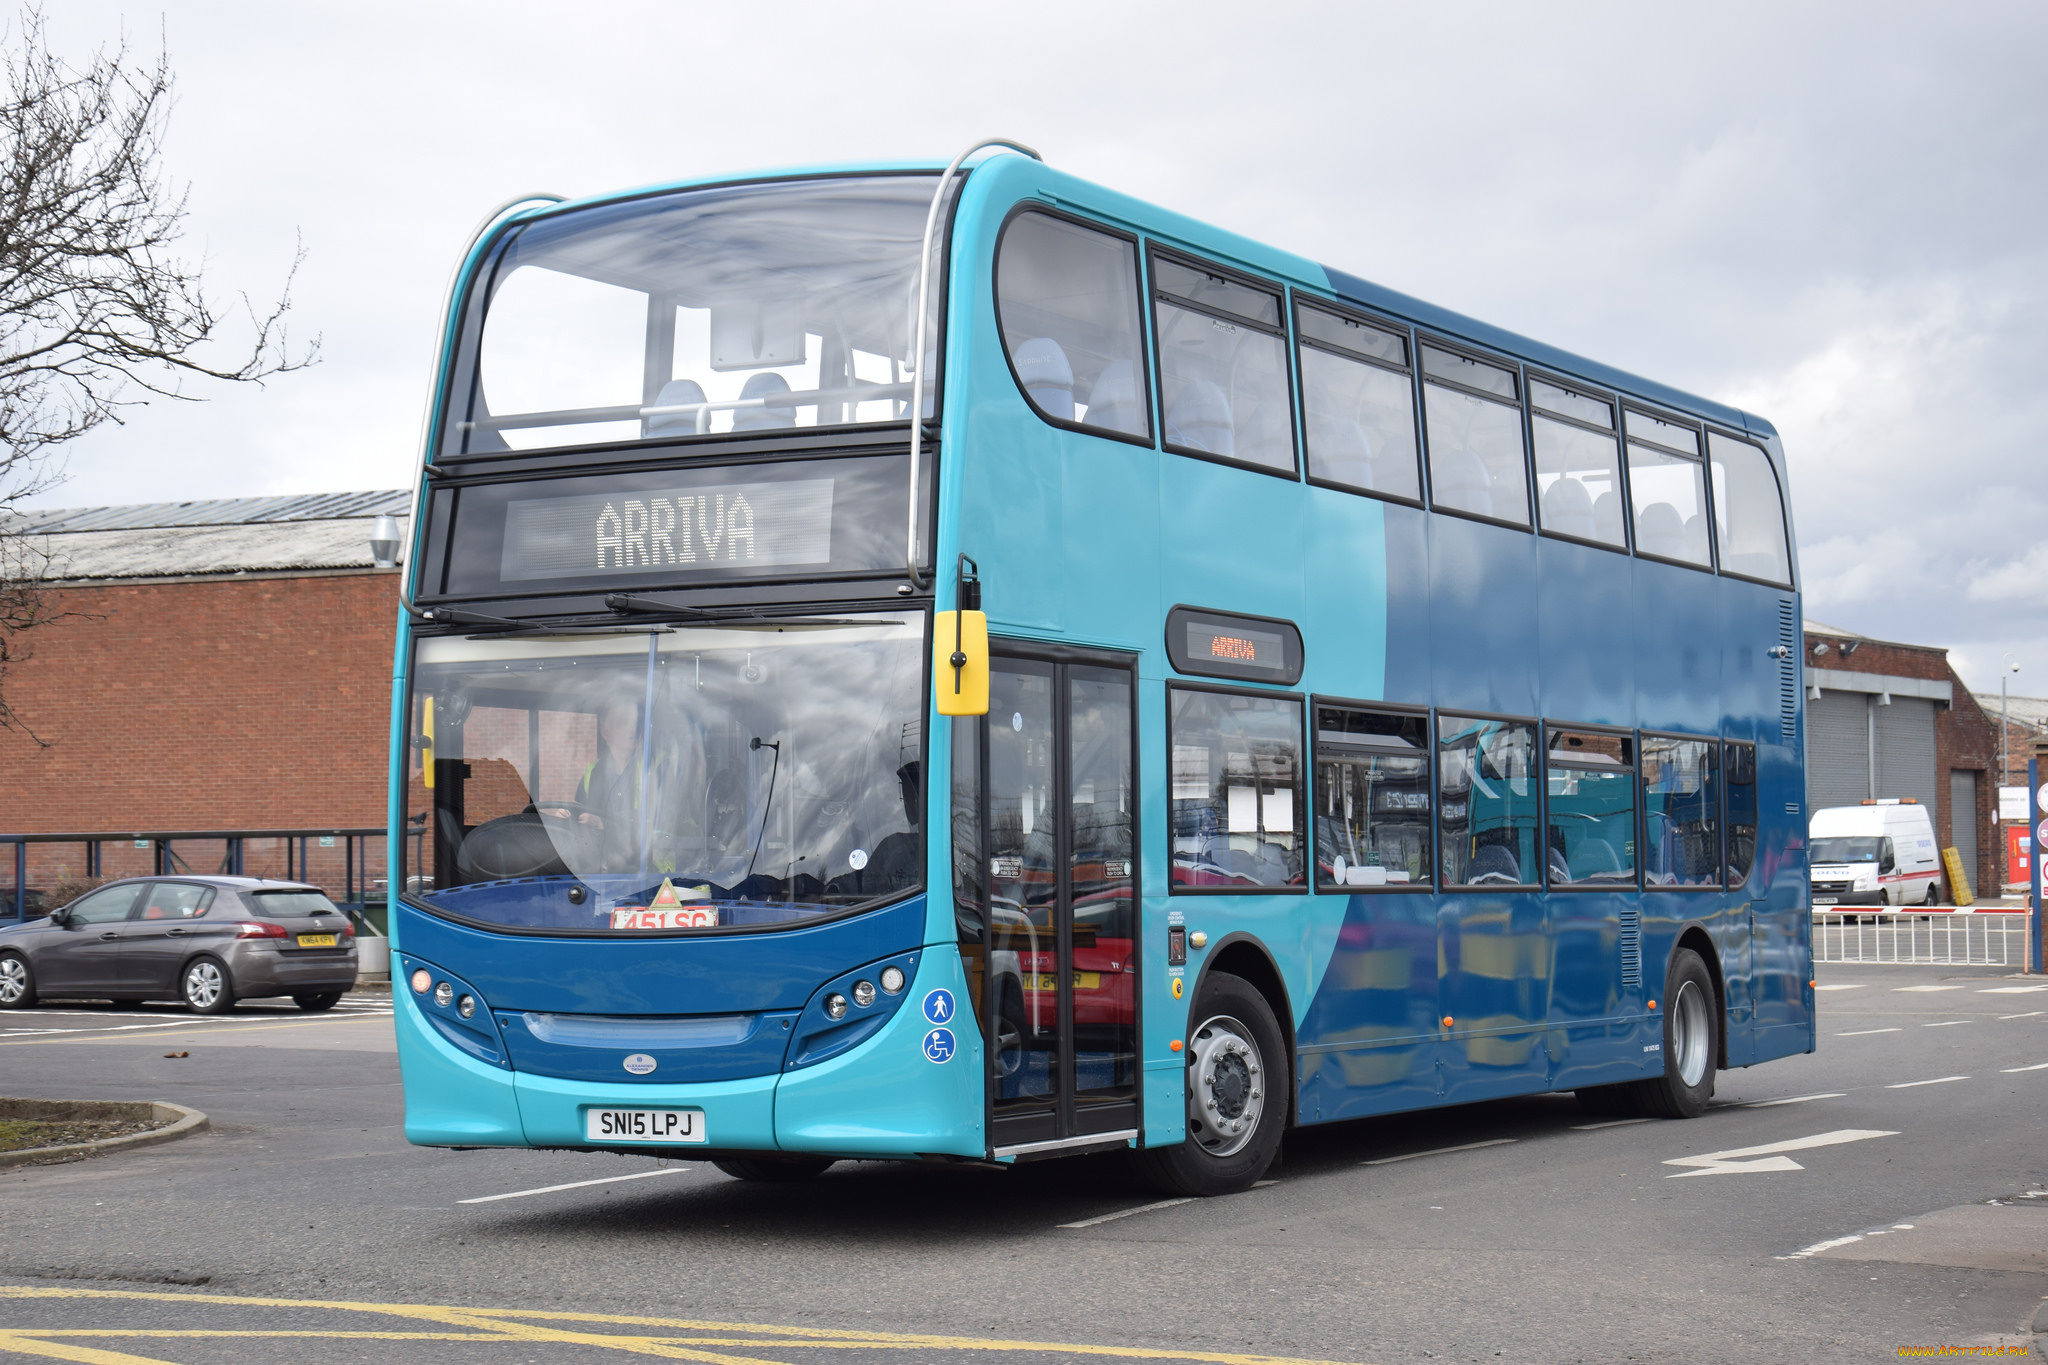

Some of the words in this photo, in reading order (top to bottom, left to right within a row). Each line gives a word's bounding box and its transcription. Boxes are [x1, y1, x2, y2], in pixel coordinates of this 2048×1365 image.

[596, 493, 754, 568] ARRIVA
[1211, 635, 1255, 661] ARRIVA
[601, 1112, 646, 1135] SN15
[652, 1113, 692, 1136] LPJ
